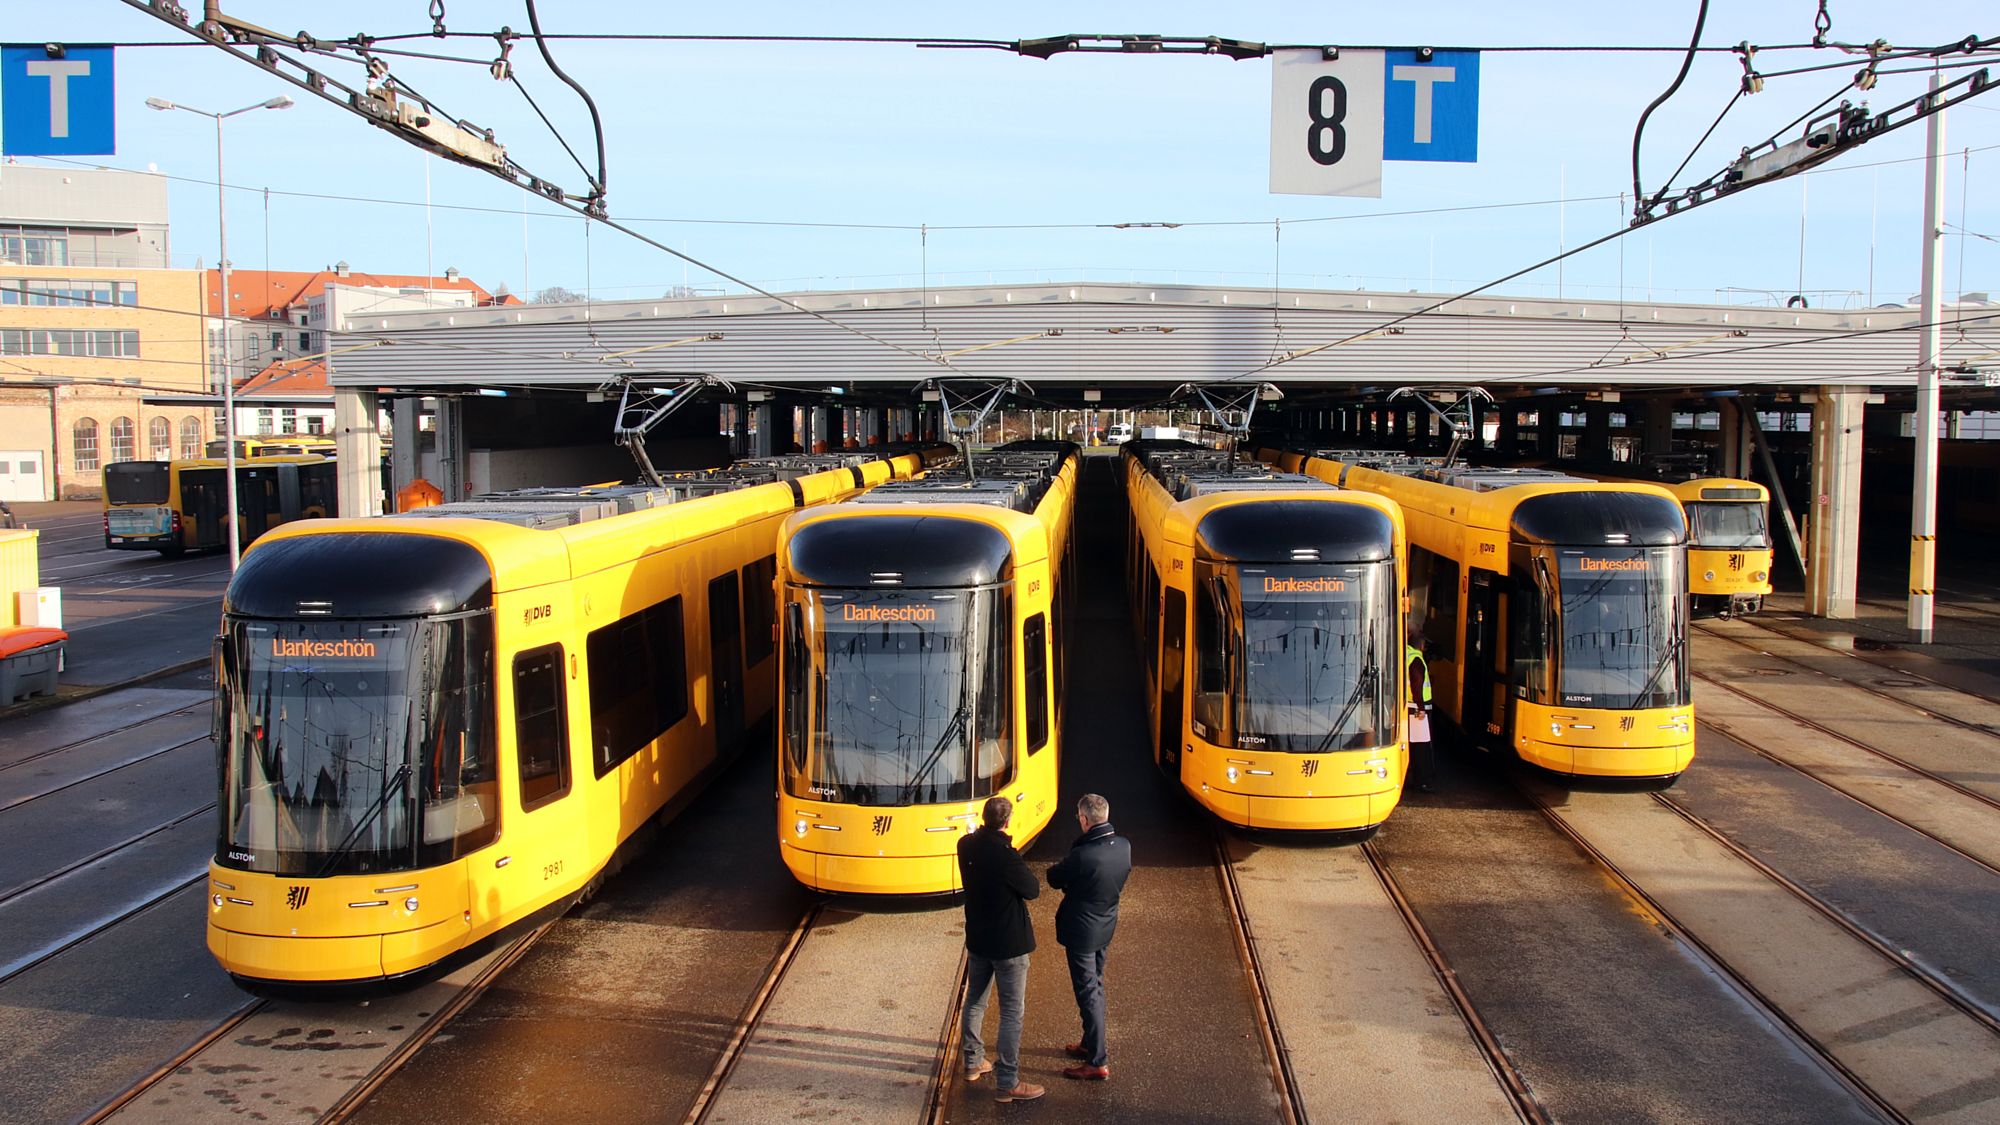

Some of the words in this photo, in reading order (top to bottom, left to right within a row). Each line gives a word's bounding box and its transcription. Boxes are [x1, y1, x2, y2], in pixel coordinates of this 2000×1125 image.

[27, 60, 90, 137] T
[1394, 66, 1456, 143] T
[1308, 76, 1347, 165] 8
[1264, 577, 1345, 592] Dankeschön
[533, 604, 552, 620] DVB
[844, 603, 936, 621] Dankeschön
[1565, 695, 1592, 703] ALSTOM
[1238, 736, 1266, 744] ALSTOM
[808, 787, 836, 796] ALSTOM
[228, 851, 256, 862] ALSTOM
[544, 860, 563, 880] 2981
